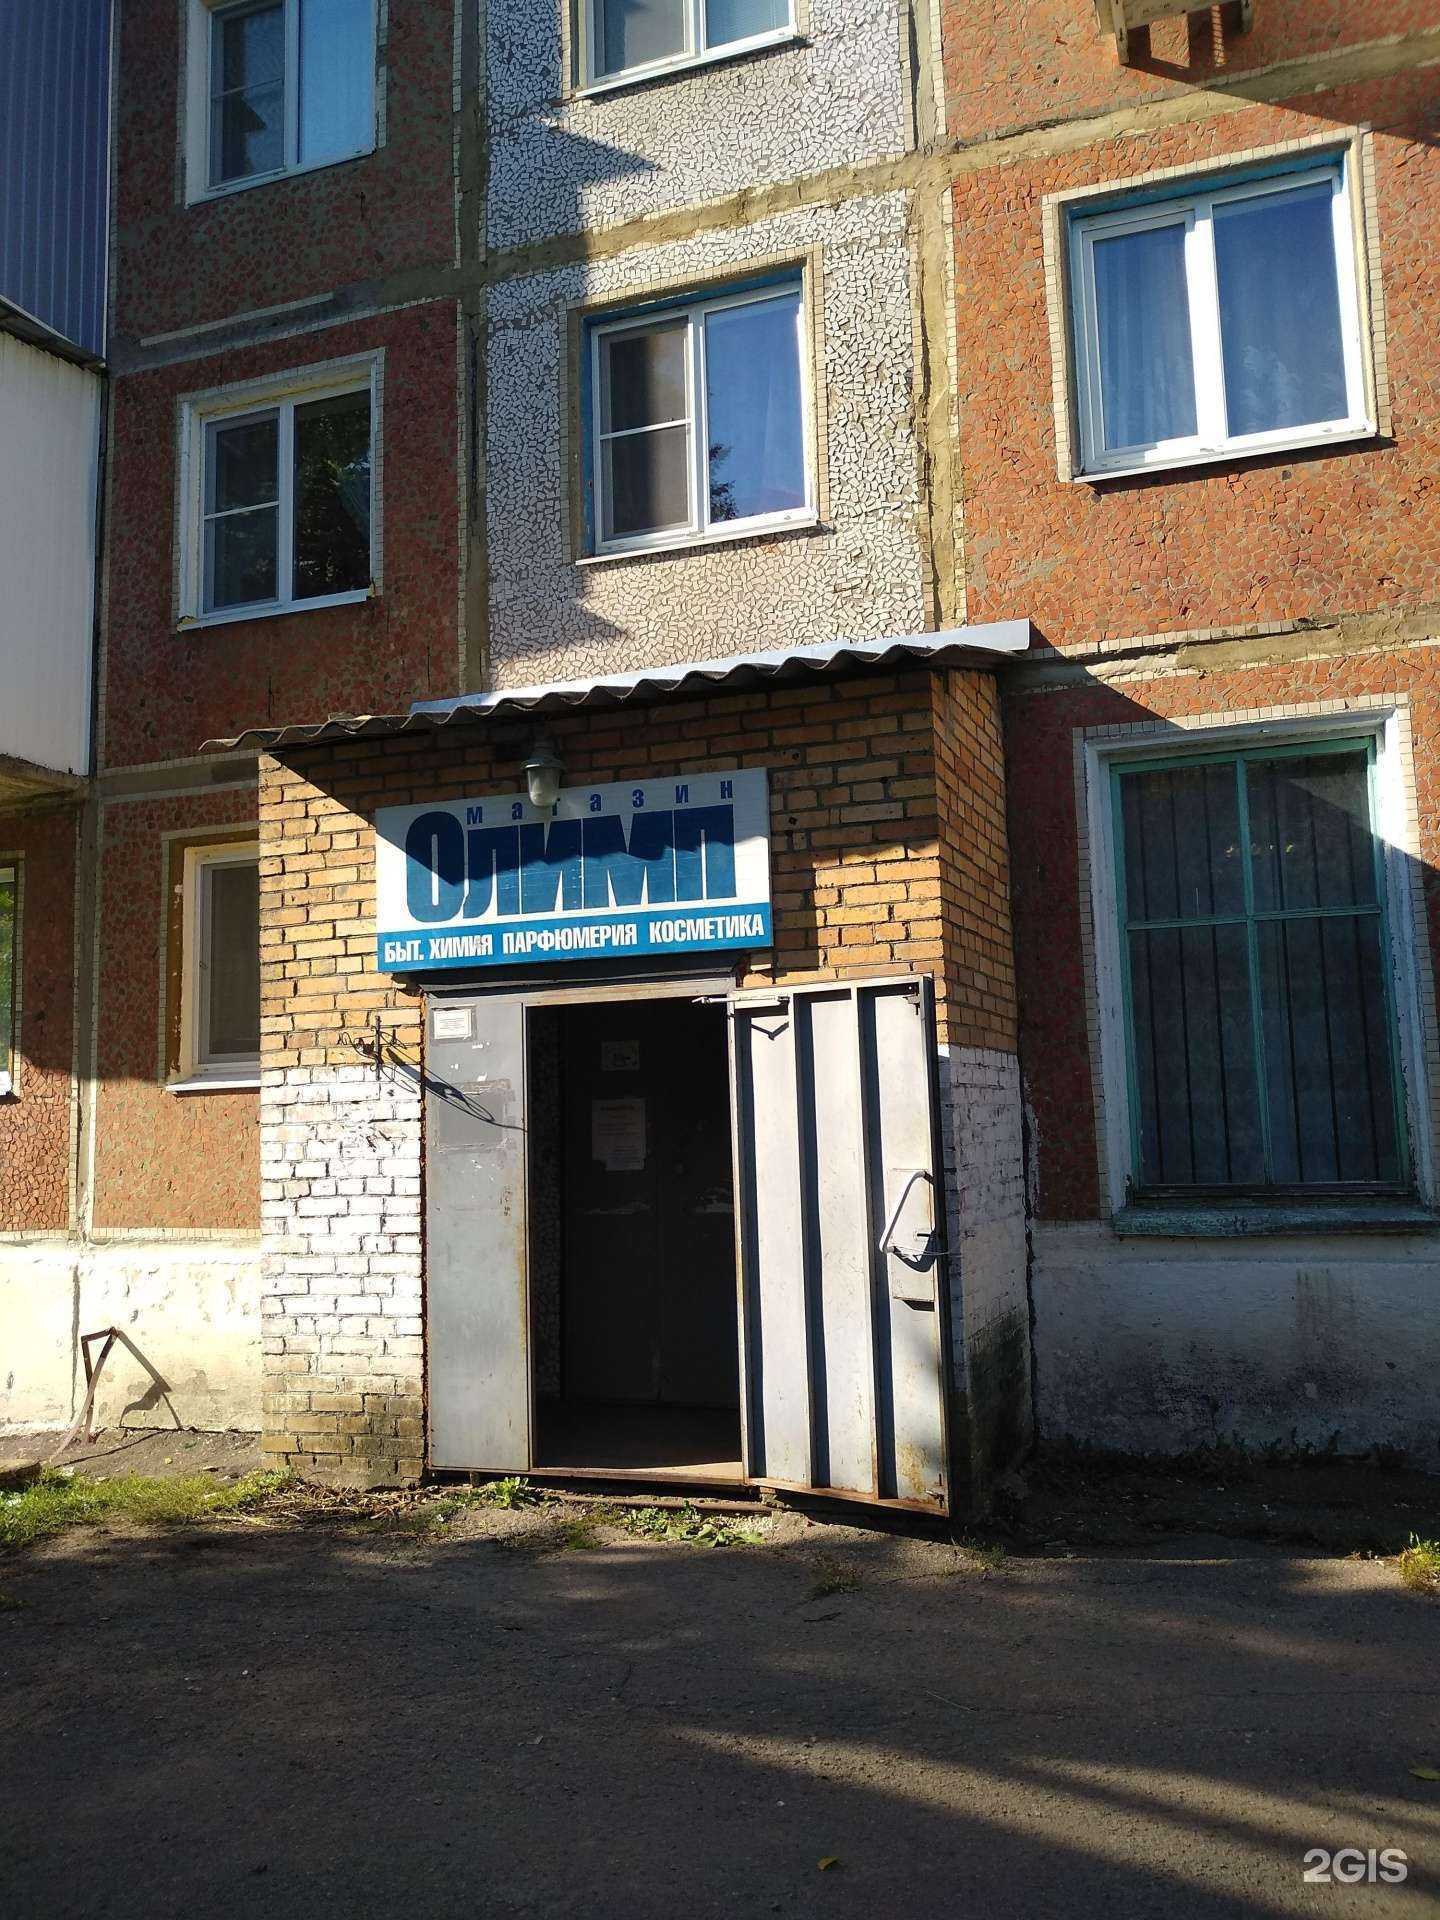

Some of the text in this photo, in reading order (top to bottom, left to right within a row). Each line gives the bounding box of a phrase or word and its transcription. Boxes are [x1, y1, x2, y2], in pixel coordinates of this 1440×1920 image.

[406, 803, 737, 923] ОЛИМП
[384, 914, 765, 963] БЫТ. ХИМИЯ ПАРФЮМЕРИЯ КОСМЕТИКА
